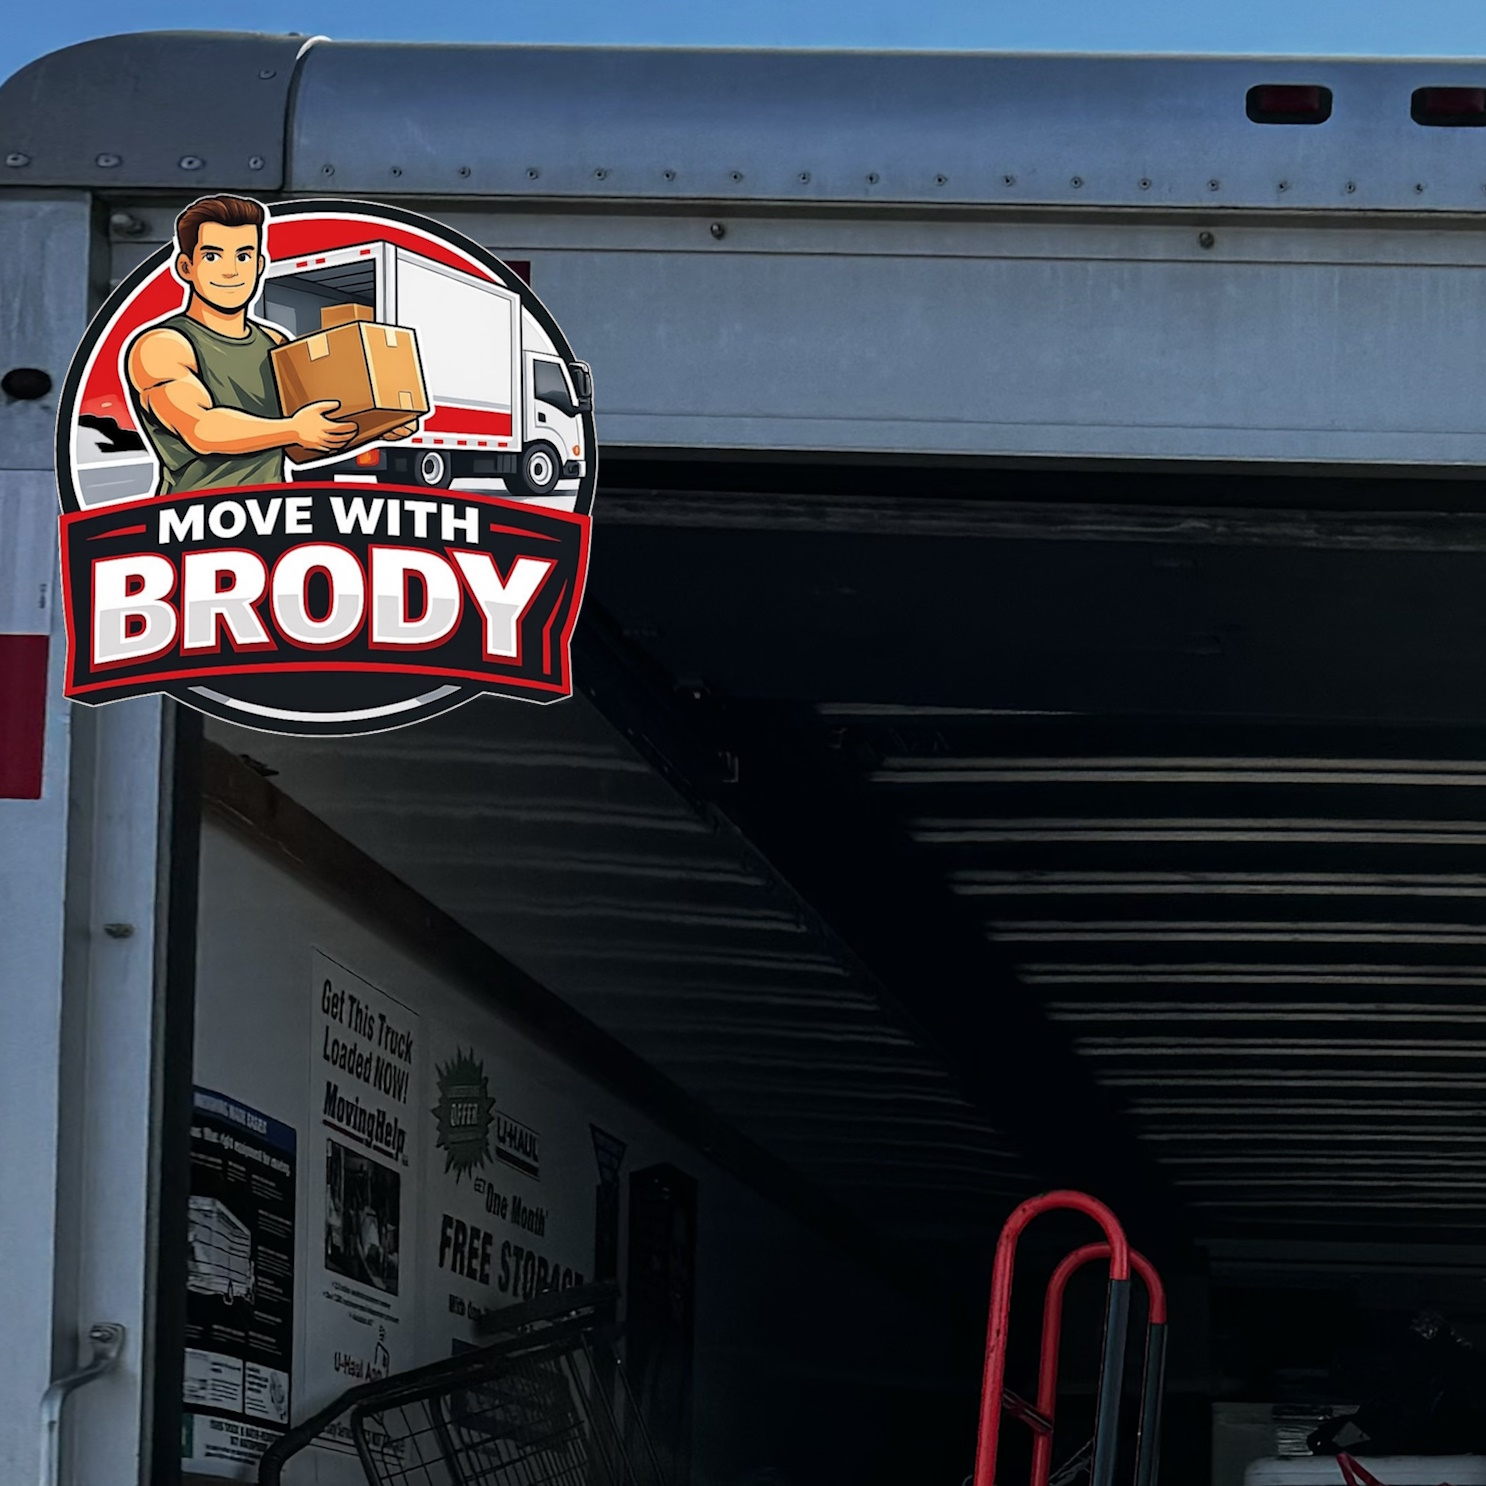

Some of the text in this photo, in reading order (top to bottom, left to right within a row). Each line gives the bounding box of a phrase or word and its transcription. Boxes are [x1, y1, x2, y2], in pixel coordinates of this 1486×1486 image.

[322, 978, 413, 1065] Get This Truck
[323, 1025, 410, 1105] Loaded NOW!
[324, 1081, 407, 1161] MovingHelp
[450, 1102, 479, 1128] OFFER
[496, 1115, 539, 1162] U-HAUL
[486, 1182, 546, 1237] One Month
[439, 1214, 493, 1286] FREE
